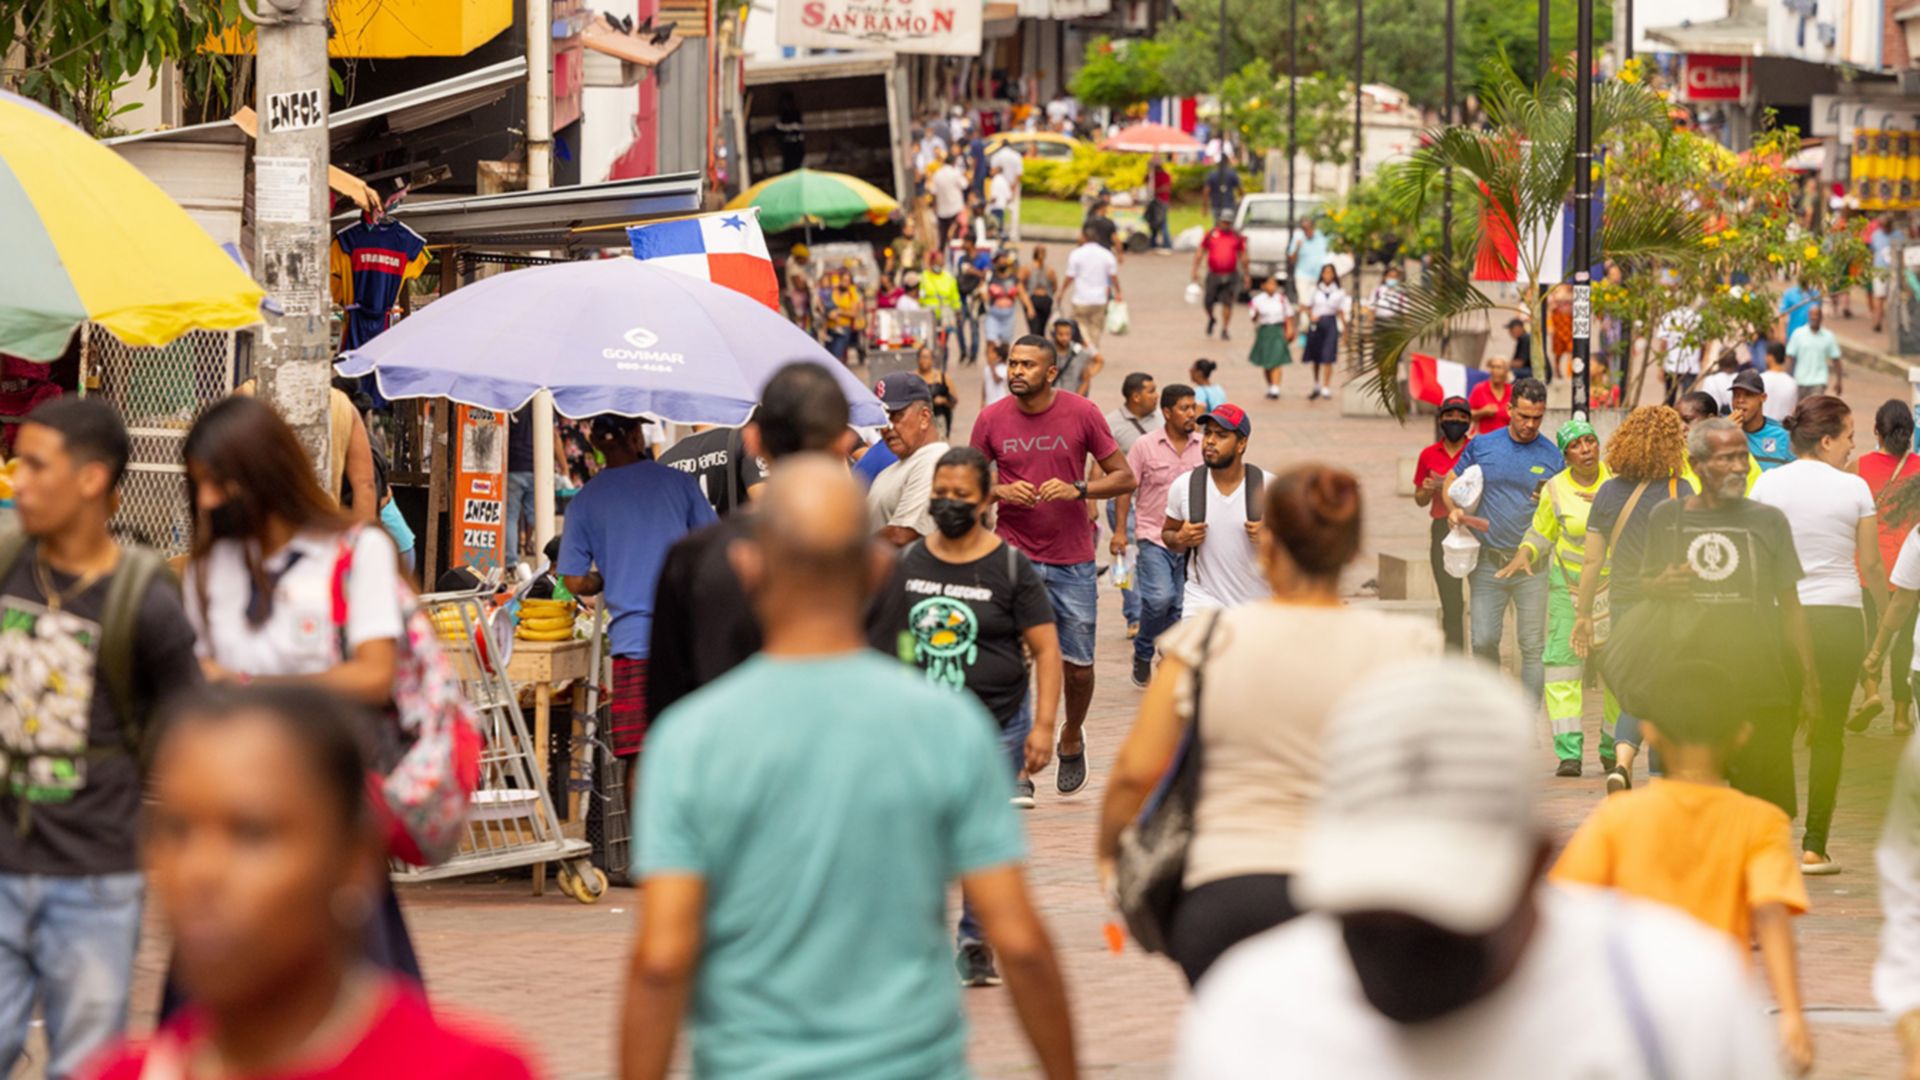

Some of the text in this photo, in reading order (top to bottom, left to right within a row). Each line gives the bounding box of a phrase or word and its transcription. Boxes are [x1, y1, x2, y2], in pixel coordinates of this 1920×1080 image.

[602, 347, 685, 365] GOVIMAR
[1002, 434, 1069, 455] RVCA
[463, 529, 497, 548] ZKEE
